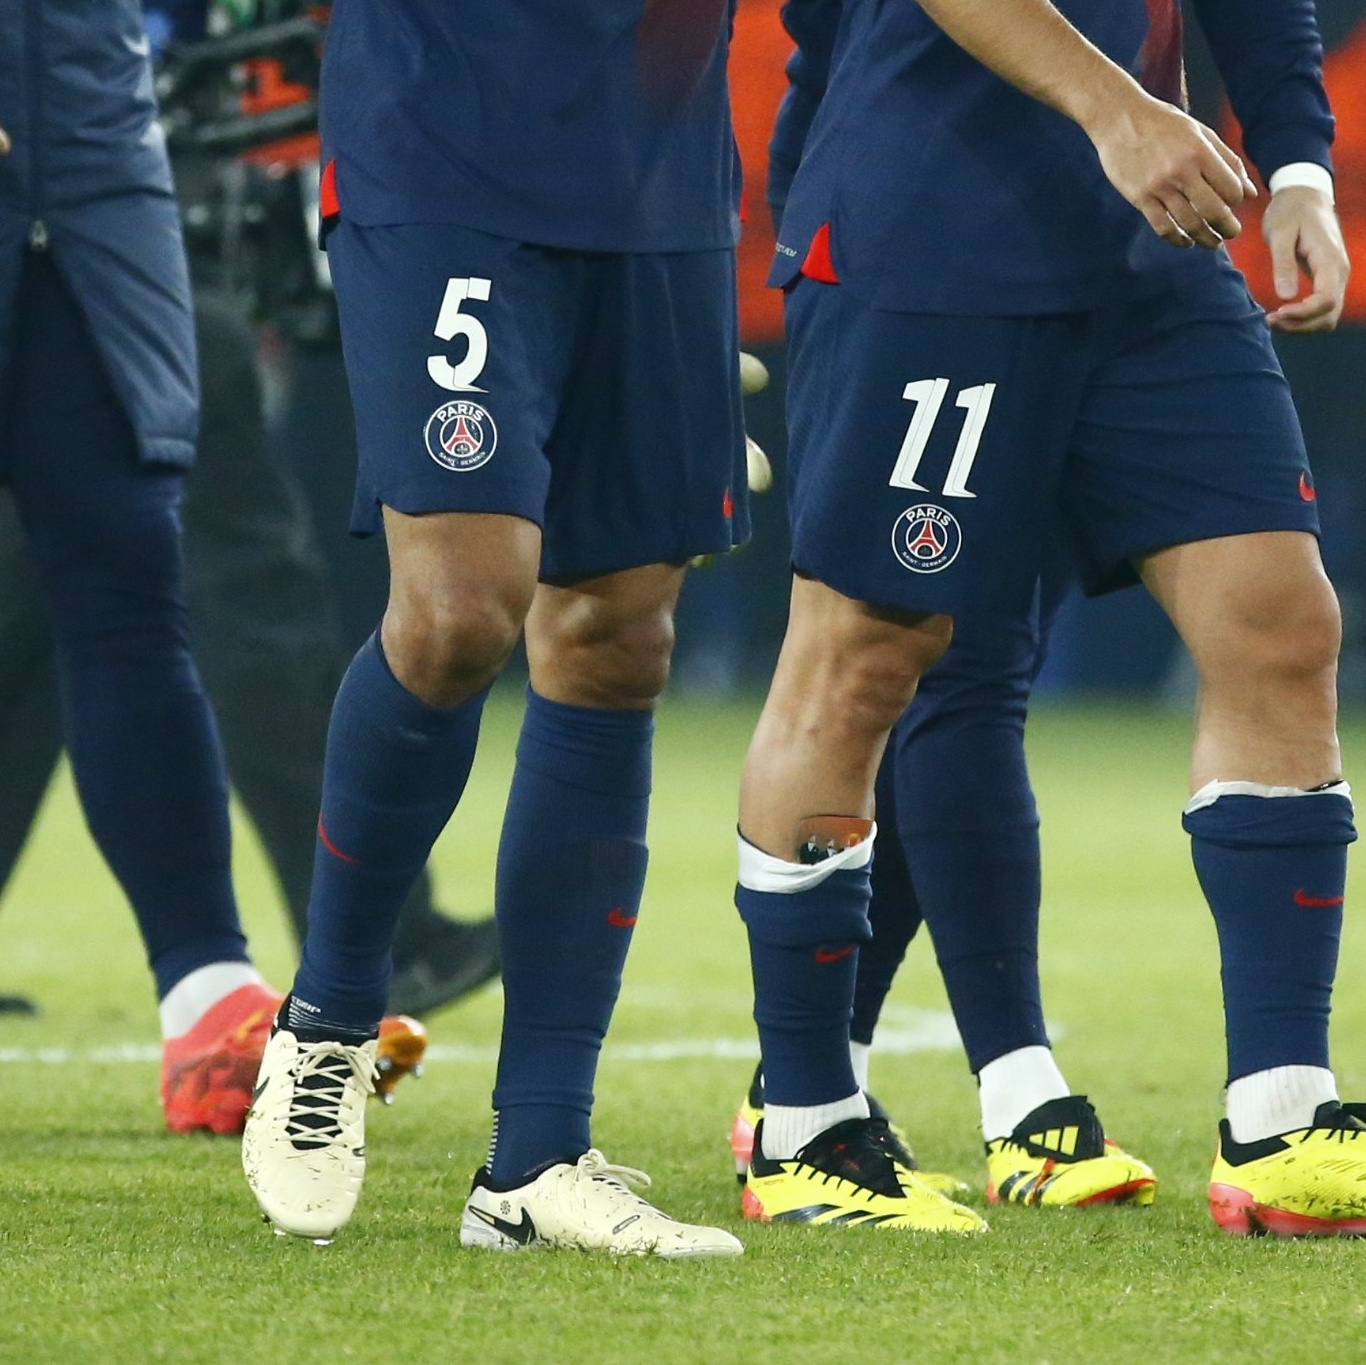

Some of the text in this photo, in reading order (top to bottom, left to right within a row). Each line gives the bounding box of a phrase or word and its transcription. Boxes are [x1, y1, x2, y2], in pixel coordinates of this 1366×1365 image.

[427, 276, 493, 394] 5
[436, 403, 484, 422] PARIS
[888, 377, 998, 499] 11
[905, 507, 952, 526] PARIS
